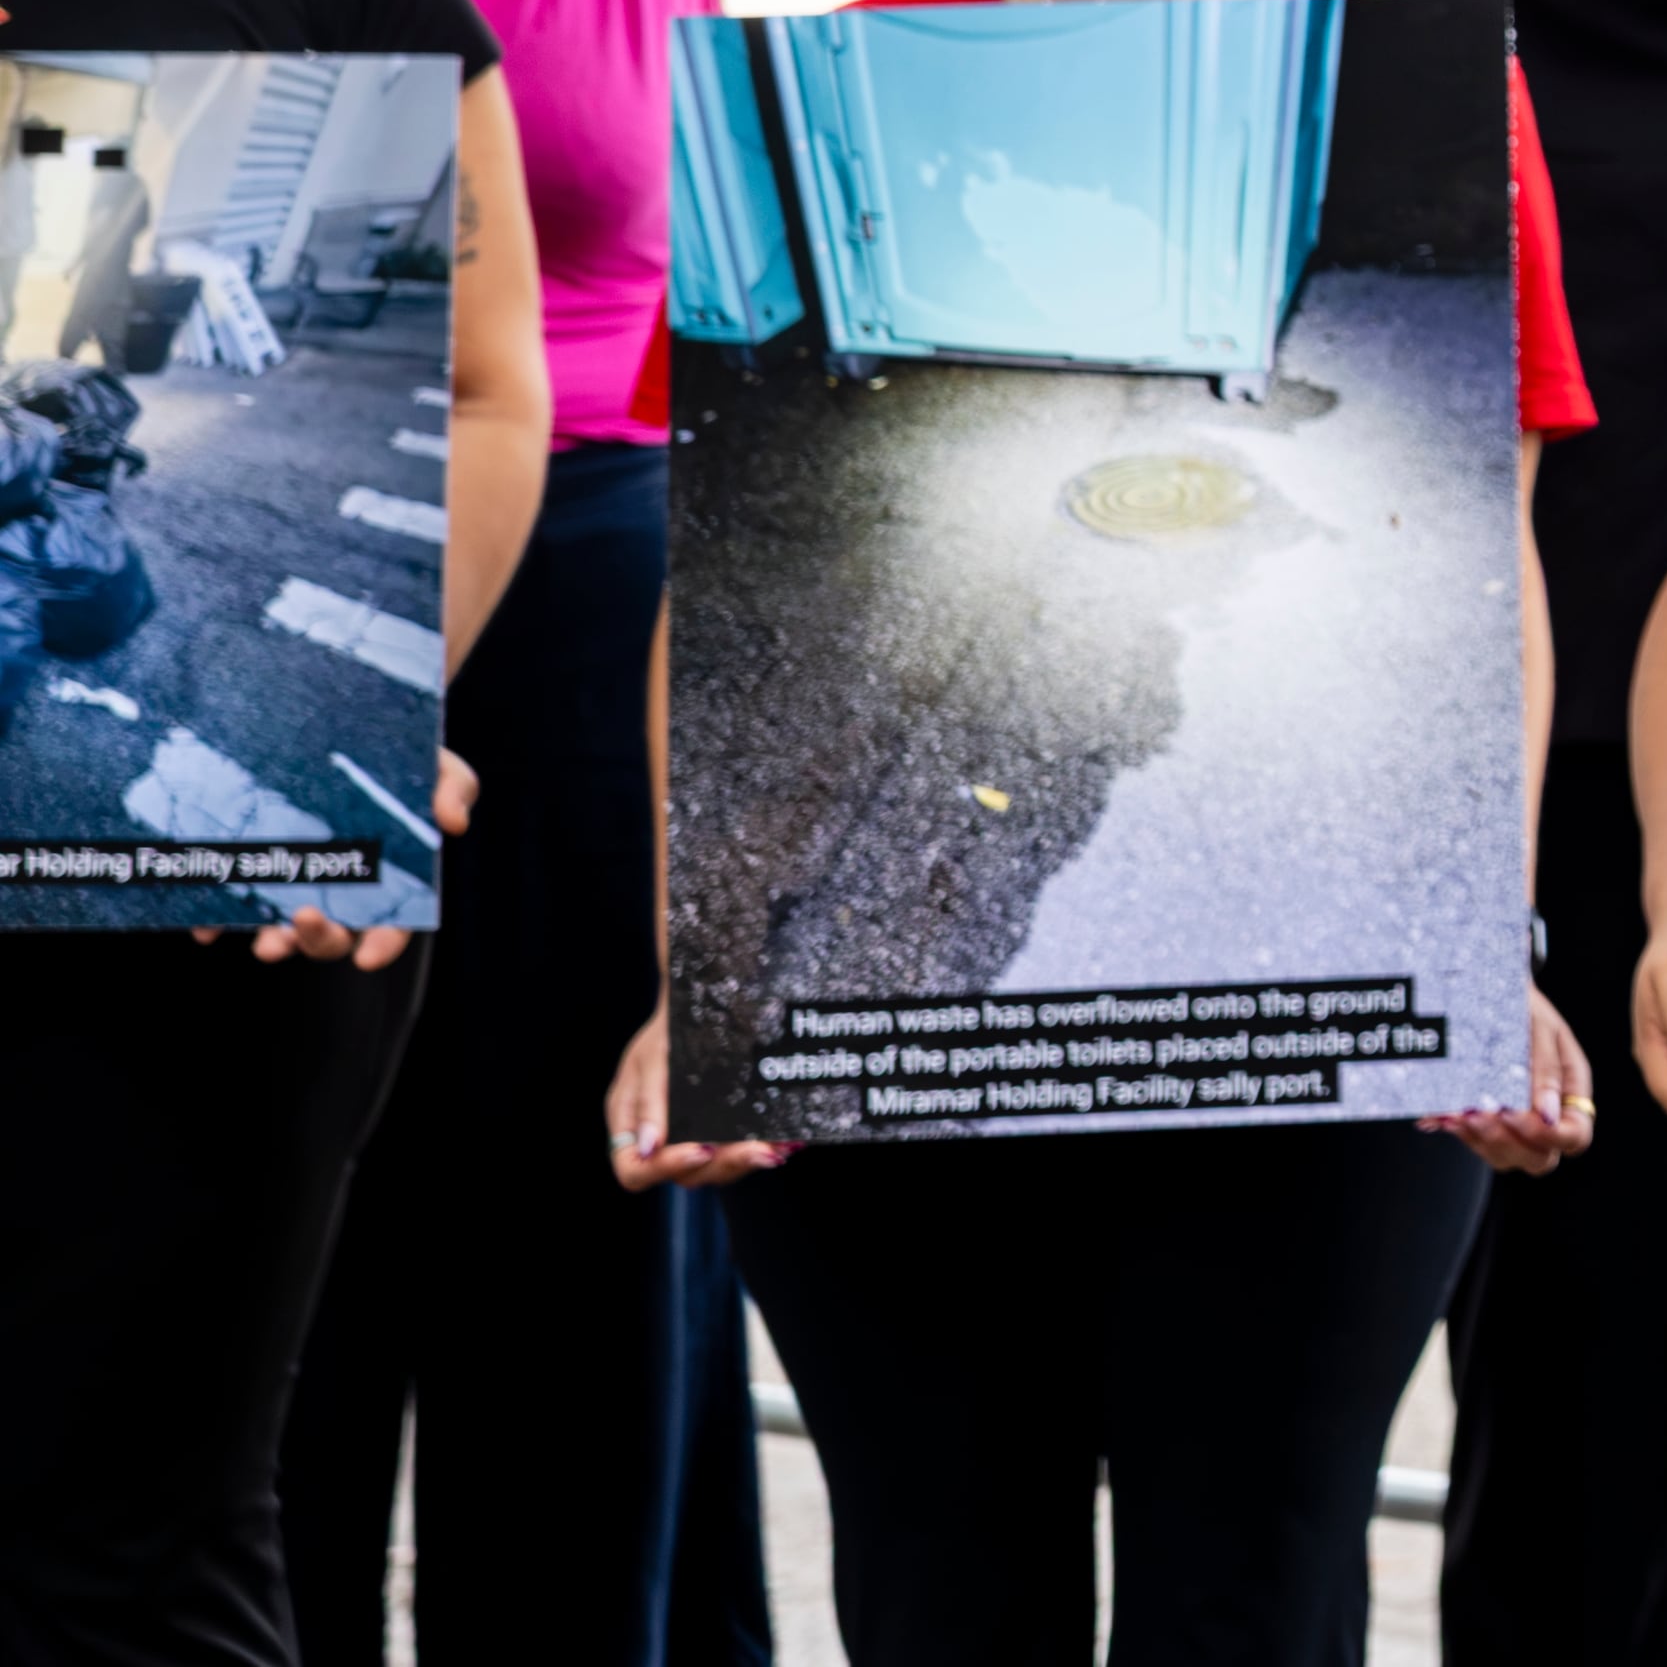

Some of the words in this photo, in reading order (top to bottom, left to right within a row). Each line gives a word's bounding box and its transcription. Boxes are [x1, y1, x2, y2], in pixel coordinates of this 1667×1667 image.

[24, 848, 134, 883] Holding
[135, 847, 235, 883] Facility
[237, 847, 303, 883] sally
[304, 850, 369, 880] port.
[792, 1009, 894, 1037] Human
[895, 1005, 981, 1032] waste
[982, 1001, 1036, 1029] has
[1037, 992, 1189, 1027] overflowed
[1191, 993, 1257, 1020] onto
[1258, 988, 1306, 1017] the
[1307, 984, 1406, 1021] ground
[758, 1048, 864, 1080] outside
[864, 1045, 899, 1076] of
[899, 1044, 948, 1074] the
[948, 1039, 1065, 1077] portable
[1065, 1036, 1154, 1066] toilets
[1155, 1031, 1249, 1068] placed
[1251, 1027, 1356, 1058] outside
[1356, 1024, 1390, 1054] of
[1391, 1024, 1439, 1052] the
[867, 1083, 984, 1115] Miramar
[986, 1079, 1094, 1112] Holding
[1096, 1075, 1195, 1108] Facility
[1197, 1071, 1263, 1107] sally
[1264, 1071, 1330, 1102] port.
